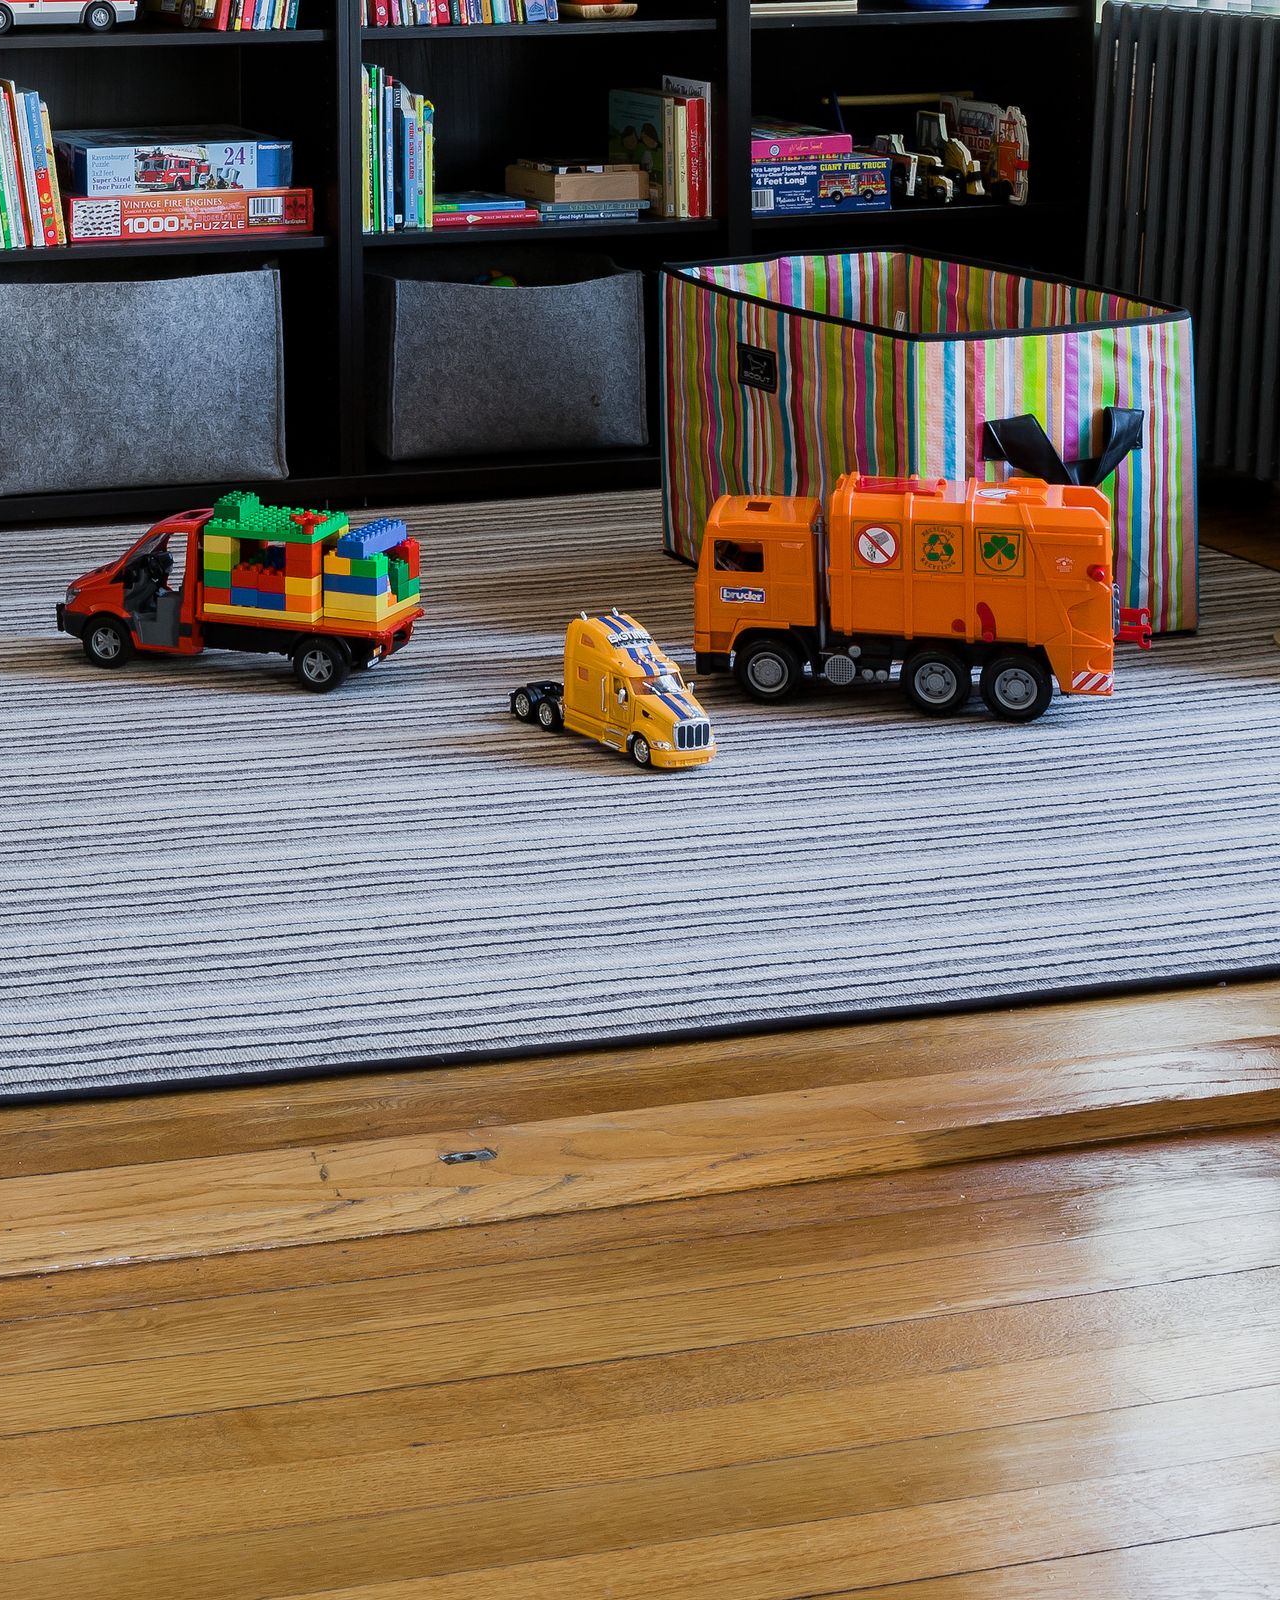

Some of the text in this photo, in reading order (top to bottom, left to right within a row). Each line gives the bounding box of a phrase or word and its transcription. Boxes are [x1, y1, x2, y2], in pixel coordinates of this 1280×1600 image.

[224, 146, 246, 166] 24
[763, 166, 781, 174] Large
[820, 161, 887, 172] GIANT FIRE TRUCK
[784, 176, 807, 186] Long!
[123, 197, 223, 209] VINTAGE FIRE ENGINES
[123, 216, 180, 233] 1000
[193, 220, 245, 231] PUZZLE
[743, 370, 771, 384] SCOUT
[921, 526, 955, 539] RECYCLING
[722, 589, 763, 601] bruder
